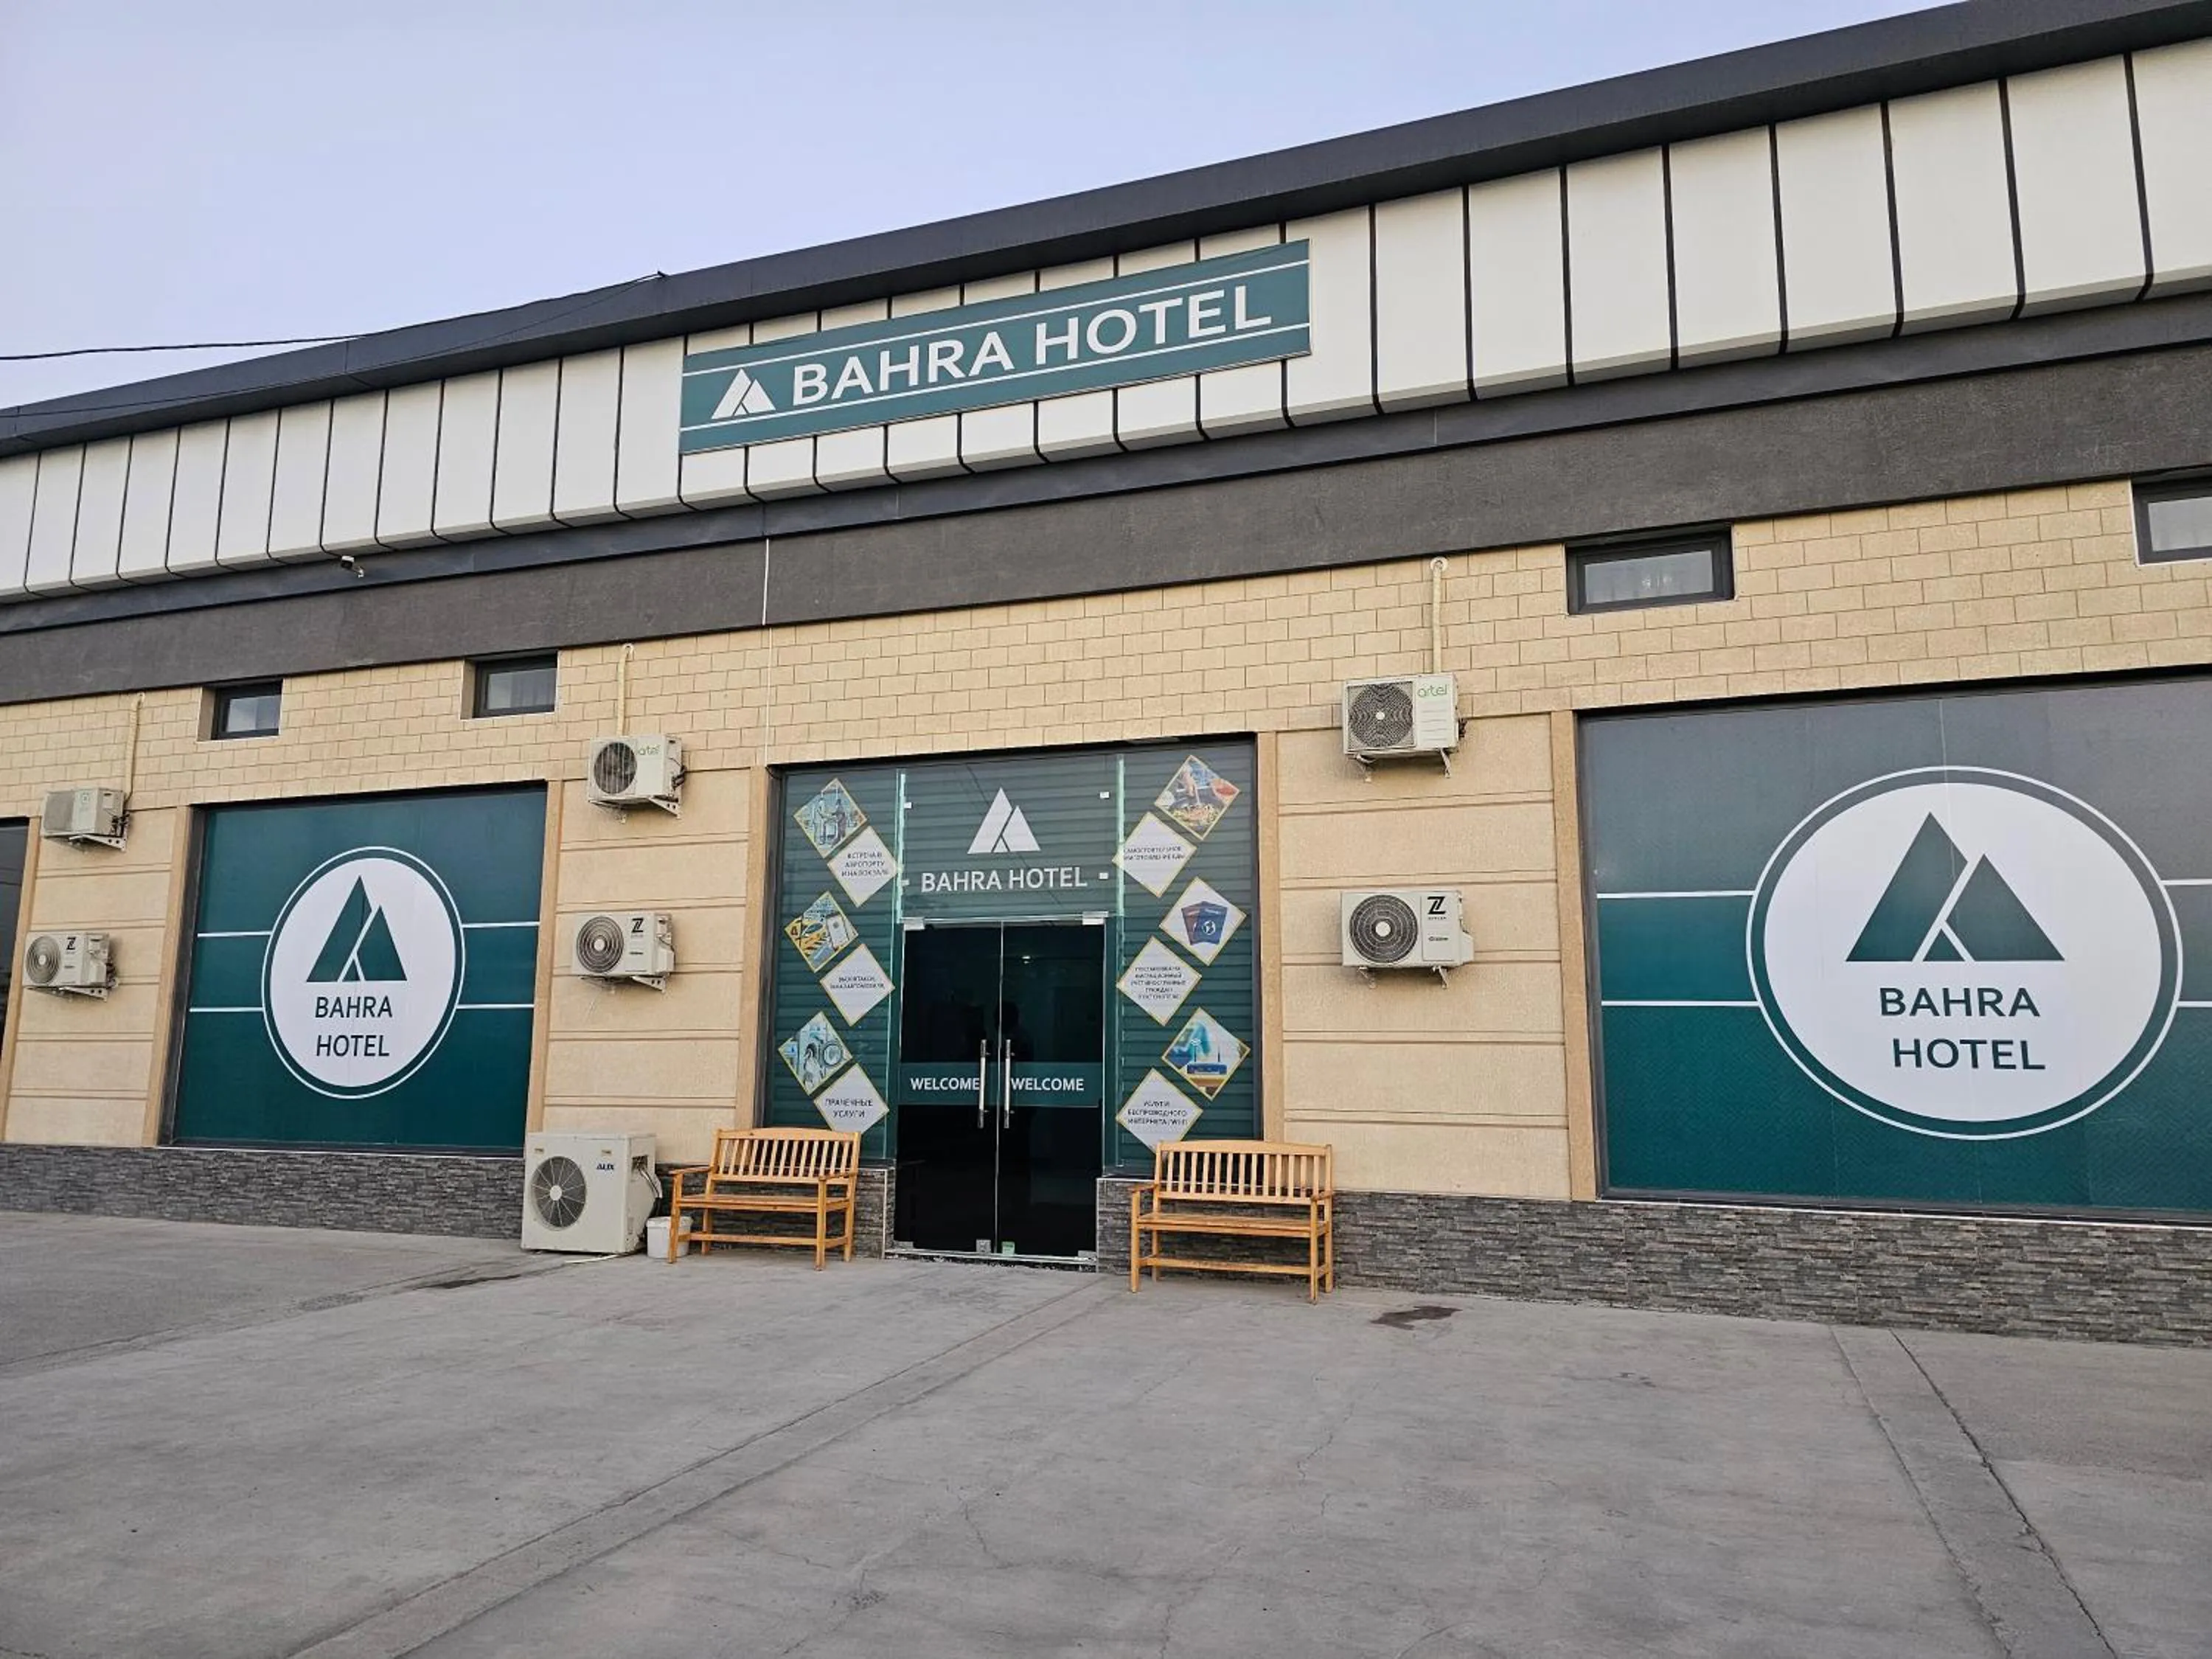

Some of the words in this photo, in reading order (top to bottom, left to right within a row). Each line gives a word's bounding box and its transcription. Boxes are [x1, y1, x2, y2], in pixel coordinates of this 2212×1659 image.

[792, 331, 1014, 406] BAHRA
[1035, 285, 1272, 366] HOTEL
[921, 869, 1002, 893] BAHRA
[1009, 866, 1088, 889] HOTEL
[315, 995, 393, 1018] BAHRA
[1880, 987, 2041, 1018] BAHRA
[316, 1034, 390, 1057] HOTEL
[1893, 1037, 2046, 1070] HOTEL
[909, 1077, 980, 1091] WELCOME
[1011, 1077, 1085, 1091] WELCOME
